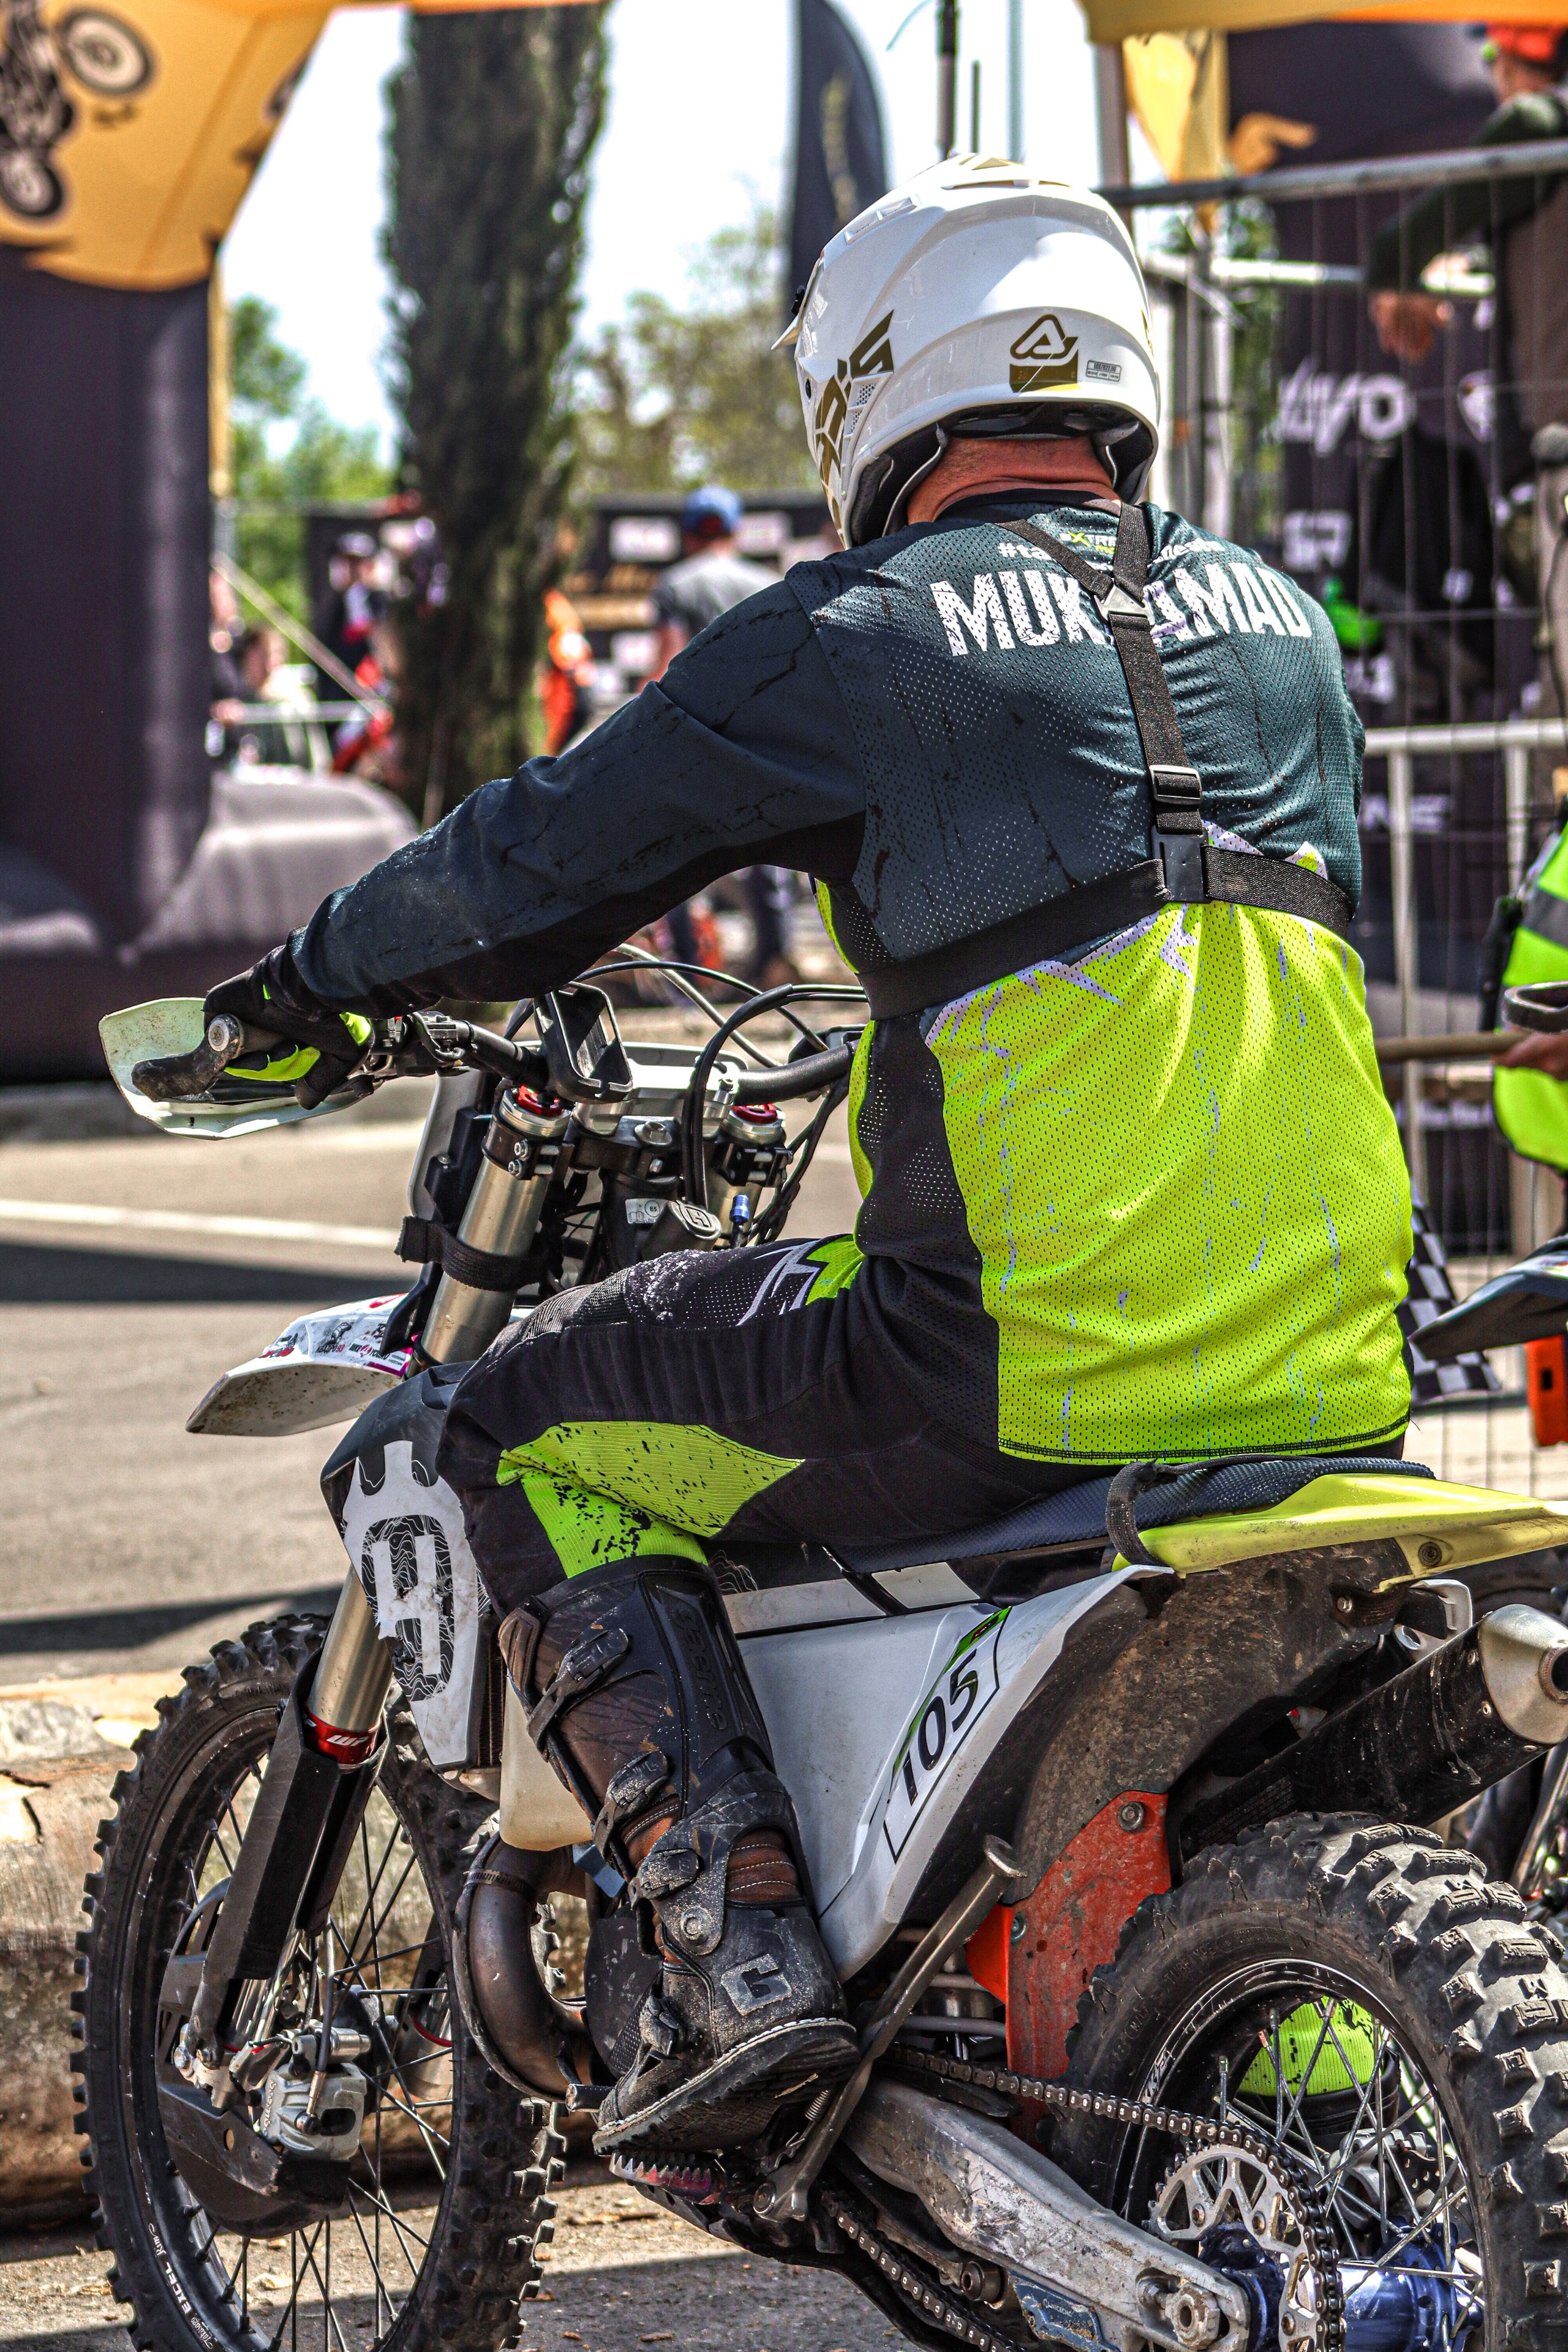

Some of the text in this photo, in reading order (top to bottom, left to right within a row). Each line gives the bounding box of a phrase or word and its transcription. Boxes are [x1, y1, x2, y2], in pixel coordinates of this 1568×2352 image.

[930, 562, 1312, 657] MUKAMAD
[902, 1648, 979, 1806] 105
[165, 2261, 192, 2314] EXCEL
